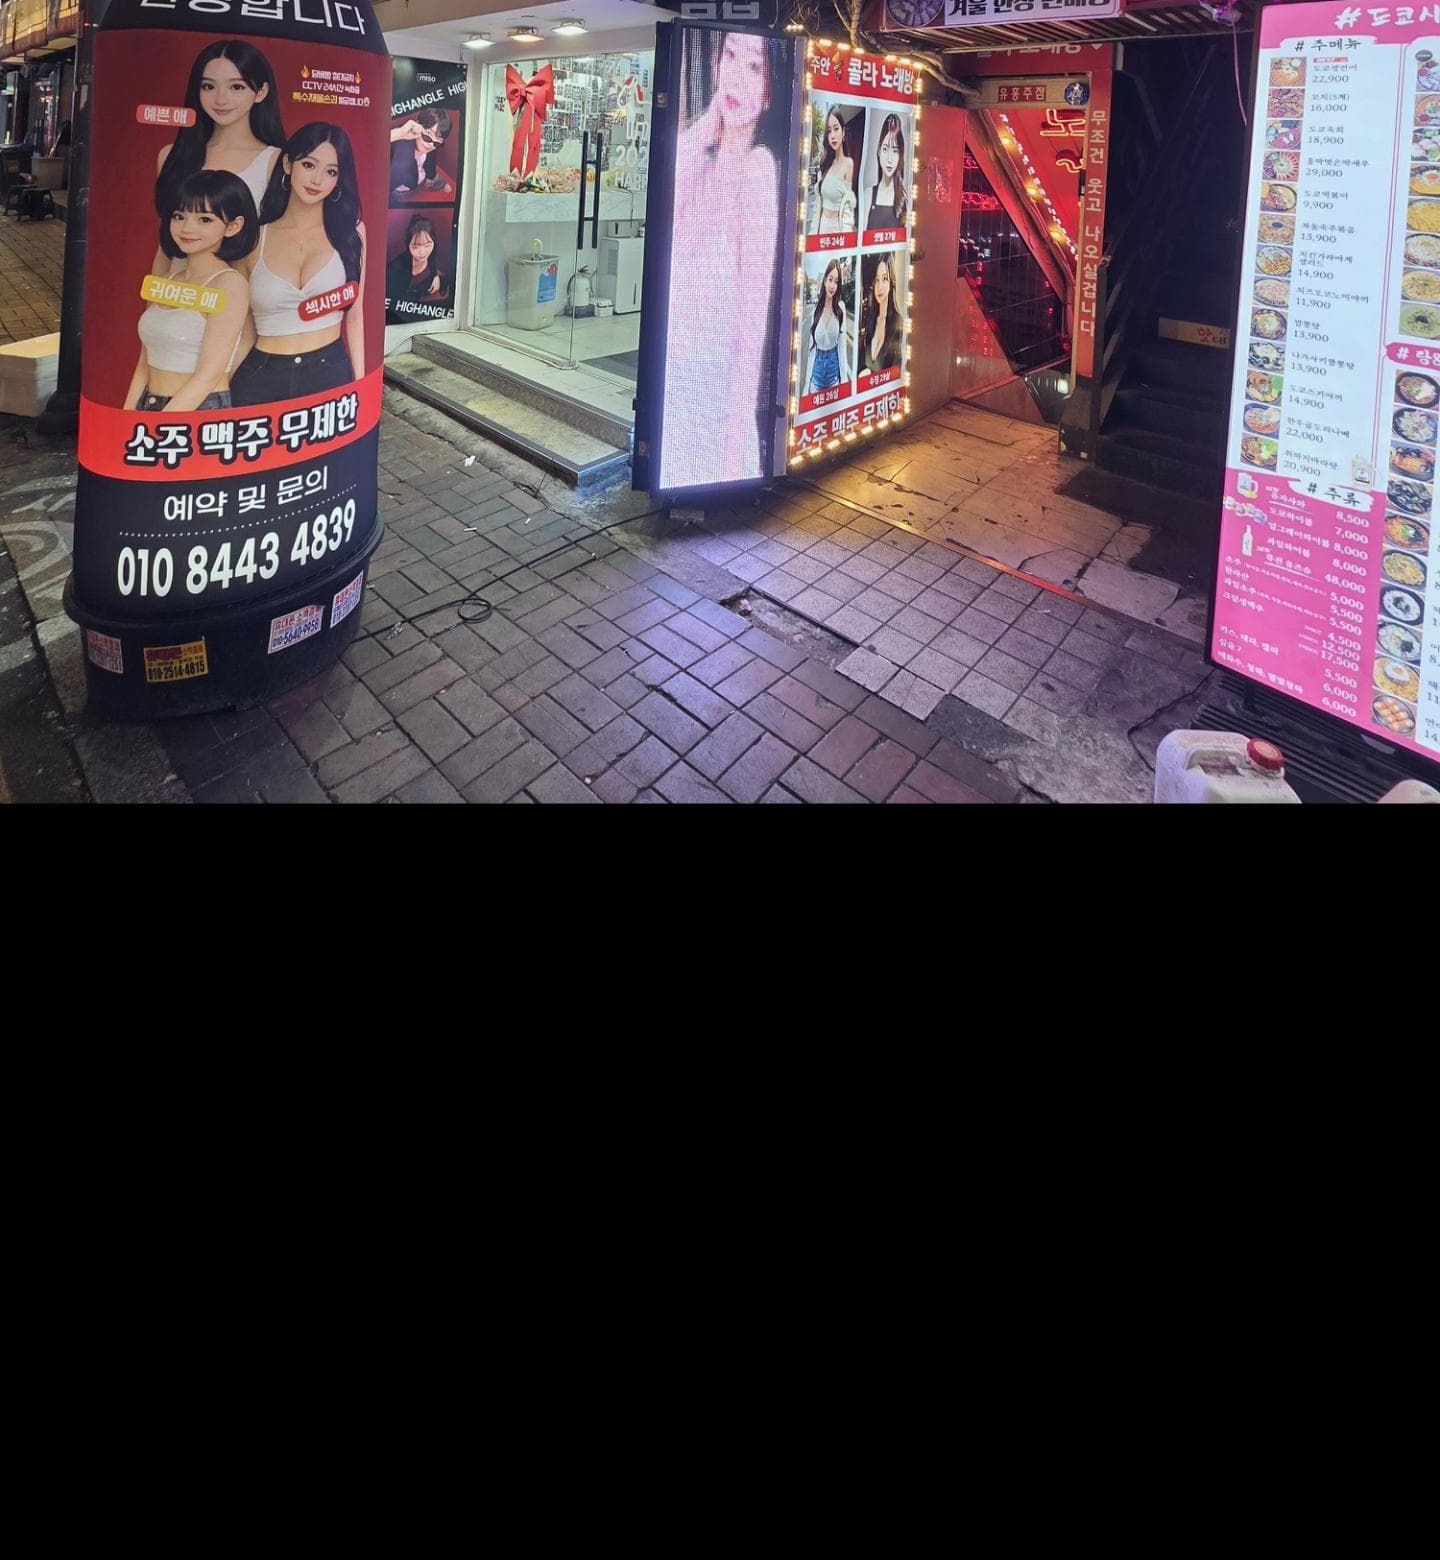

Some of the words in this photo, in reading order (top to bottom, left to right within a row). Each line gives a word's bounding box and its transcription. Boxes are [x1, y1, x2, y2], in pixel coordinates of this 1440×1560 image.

[1311, 37, 1361, 51] 주메뉴
[848, 57, 878, 88] 콜라
[880, 64, 914, 95] 노래방
[1312, 75, 1349, 83] 22,900
[390, 89, 445, 117] IGHANGLE
[1000, 87, 1047, 102] 유흥주점
[143, 107, 172, 123] 예쁜
[174, 109, 188, 124] 애
[1310, 104, 1347, 112] 16,000
[1090, 110, 1107, 165] 무조건
[1308, 136, 1344, 145] 18,900
[1305, 168, 1343, 177] 29,000
[1303, 200, 1333, 210] 9,900
[1298, 269, 1334, 280] 14,900
[149, 280, 198, 306] 귀여운
[201, 289, 219, 308] 애
[304, 290, 341, 316] 섹시한
[342, 284, 354, 304] 애
[1296, 297, 1331, 309] 11,900
[395, 300, 455, 319] HIGHANGLE
[1294, 329, 1329, 342] 13,900
[1289, 394, 1324, 409] 14,900
[126, 424, 188, 465] 소주
[201, 417, 269, 460] 맥주
[279, 393, 358, 449] 무제한
[1286, 427, 1323, 443] 22,000
[1283, 460, 1320, 477] 20,900
[164, 491, 228, 521] 예약
[238, 484, 266, 514] 및
[276, 466, 329, 505] 문의
[1325, 487, 1360, 507] 주류
[1336, 511, 1369, 528] 8,500
[1335, 526, 1369, 544] 7,000
[117, 545, 174, 597] 010
[186, 532, 280, 595] 8443
[290, 498, 356, 567] 4839
[1334, 543, 1368, 560] 8,000
[1333, 558, 1367, 576] 8,000
[1324, 573, 1366, 594] 48,000
[1330, 592, 1364, 611] 5,000
[1330, 604, 1363, 623] 5,500
[1329, 617, 1362, 636] 5,500
[1321, 640, 1360, 661] 12,500
[1328, 632, 1361, 651] 4,500
[1321, 650, 1359, 672] 17,500
[1324, 668, 1358, 688] 5,500
[1323, 683, 1357, 703] 6,000
[1322, 697, 1356, 717] 6,000
